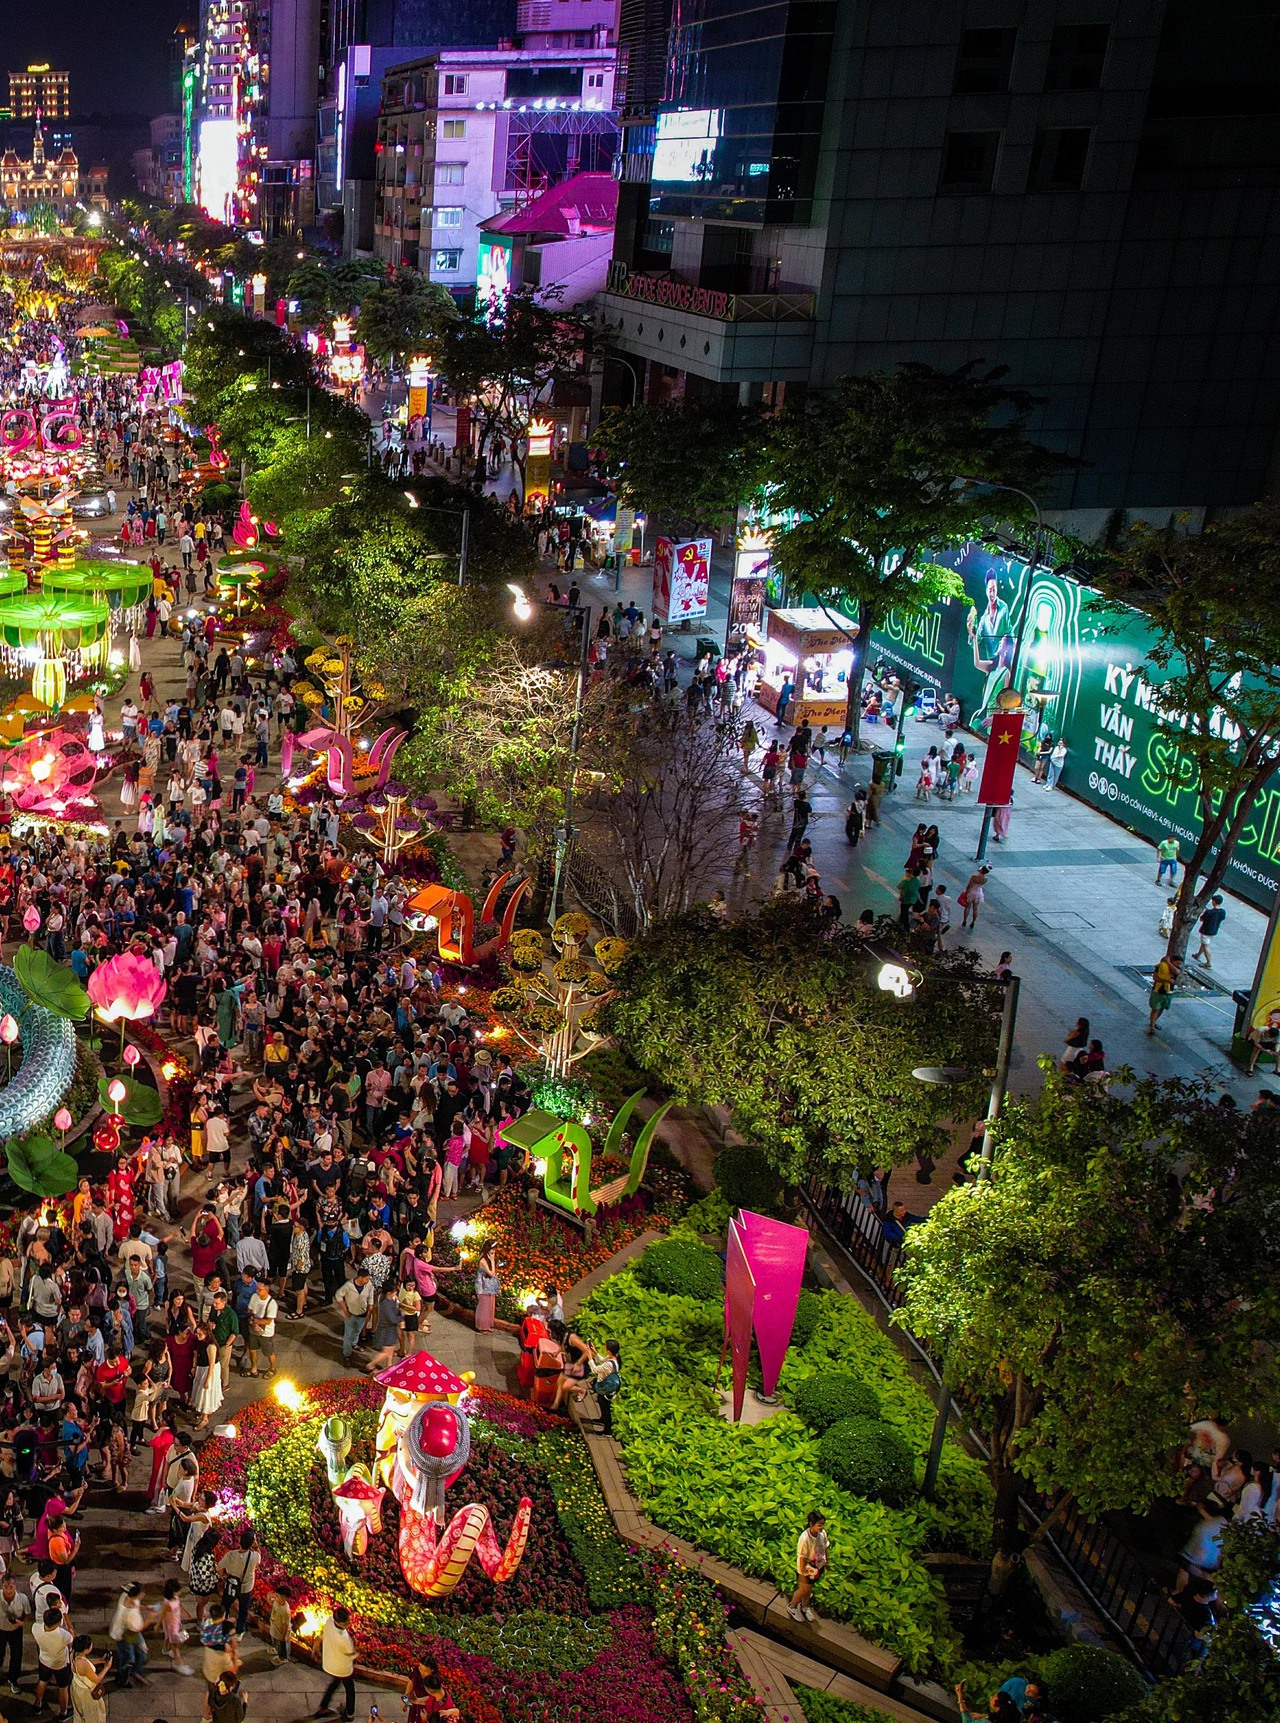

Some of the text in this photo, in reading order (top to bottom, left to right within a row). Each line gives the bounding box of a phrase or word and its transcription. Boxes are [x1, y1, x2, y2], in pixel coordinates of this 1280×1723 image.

[630, 275, 656, 299] OFFICE
[657, 280, 690, 307] SERVICE
[691, 287, 727, 317] CENTER
[736, 594, 761, 603] HAPPY
[738, 602, 758, 611] NEW
[732, 622, 761, 634] 205
[738, 612, 758, 621] YEAR
[1104, 662, 1135, 700] KỶ
[1100, 702, 1135, 742] VẪN
[1094, 736, 1137, 779] THẤY
[1142, 733, 1280, 866] SPCI
[1232, 858, 1279, 891] KHÔNG ĐƯỢC
